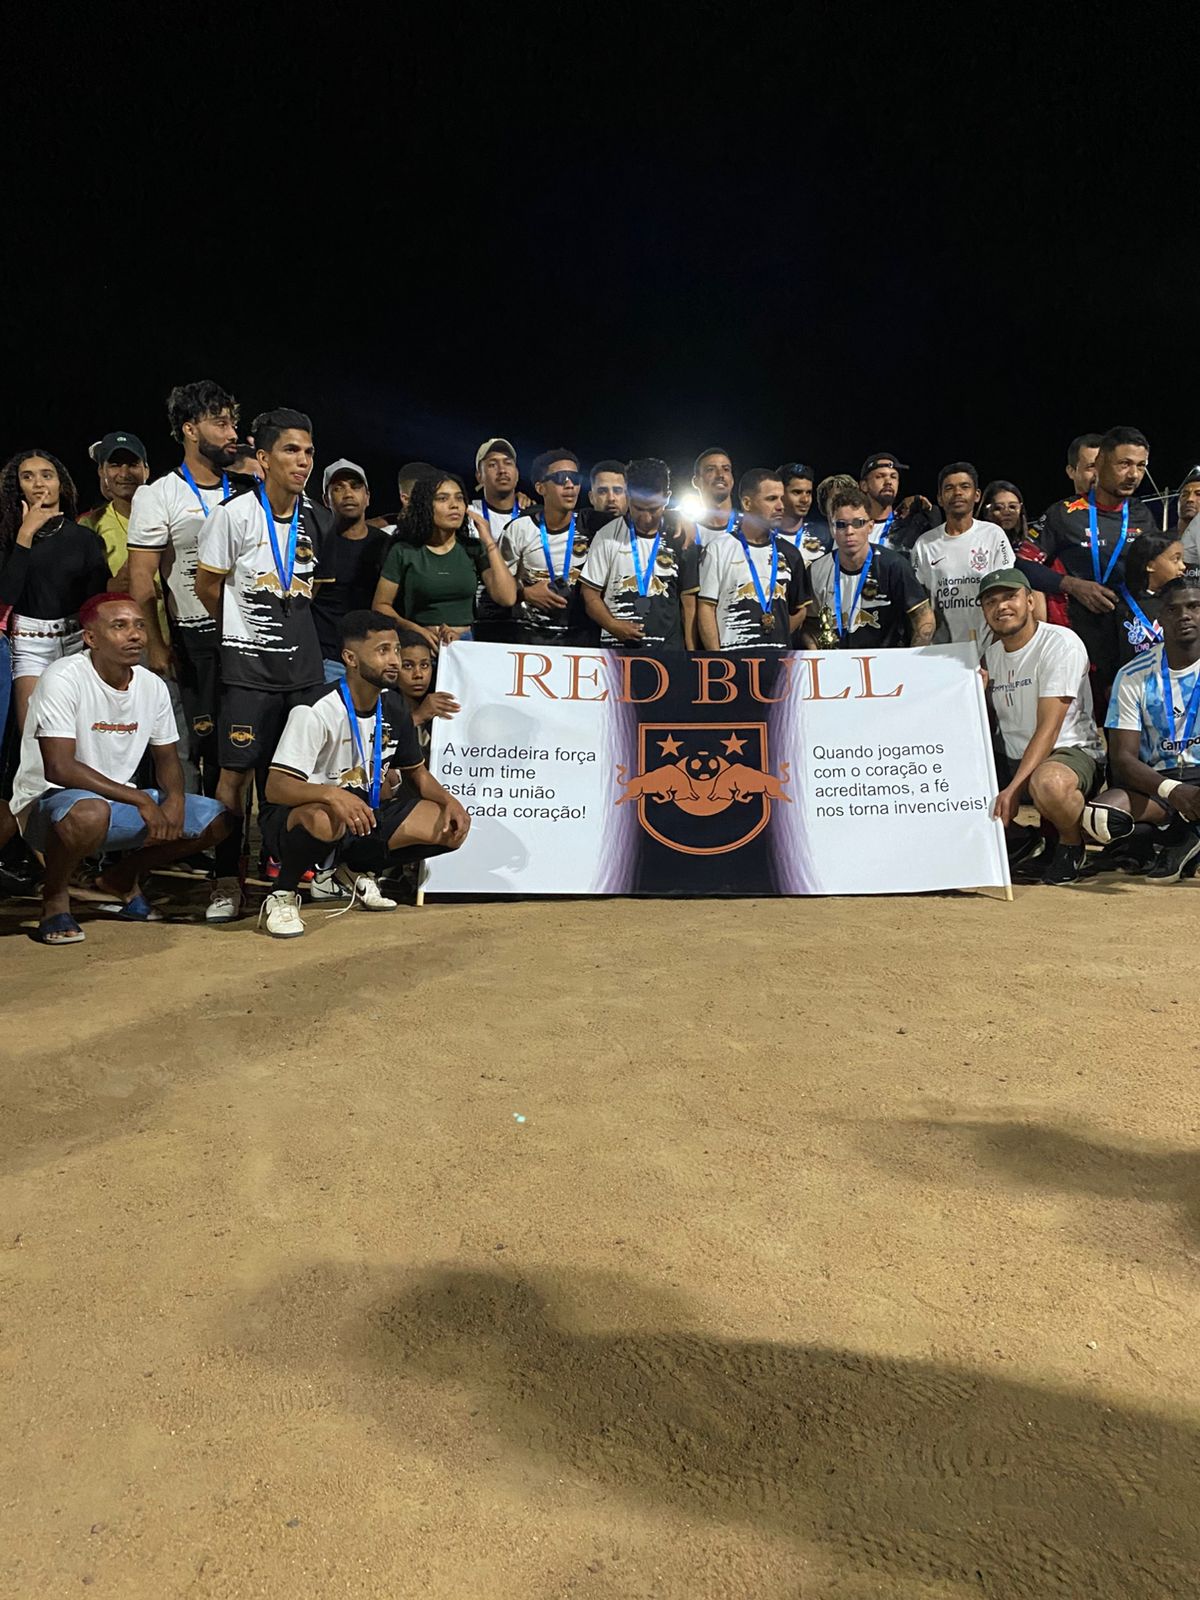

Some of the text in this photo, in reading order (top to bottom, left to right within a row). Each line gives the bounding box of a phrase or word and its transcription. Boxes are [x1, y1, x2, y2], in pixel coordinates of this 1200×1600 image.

[938, 576, 981, 586] vitaminas
[936, 587, 960, 598] neo
[505, 651, 904, 704] RED BULL
[443, 743, 596, 765] A verdadeira força
[813, 743, 944, 760] Quando jogamos
[442, 762, 536, 779] de um time
[814, 762, 942, 779] com o coração e
[482, 786, 503, 798] na
[509, 785, 555, 799] união
[815, 778, 949, 797] acreditamos, a fé
[466, 804, 586, 822] cada coração!
[816, 796, 988, 817] nos torna invencíveis!
